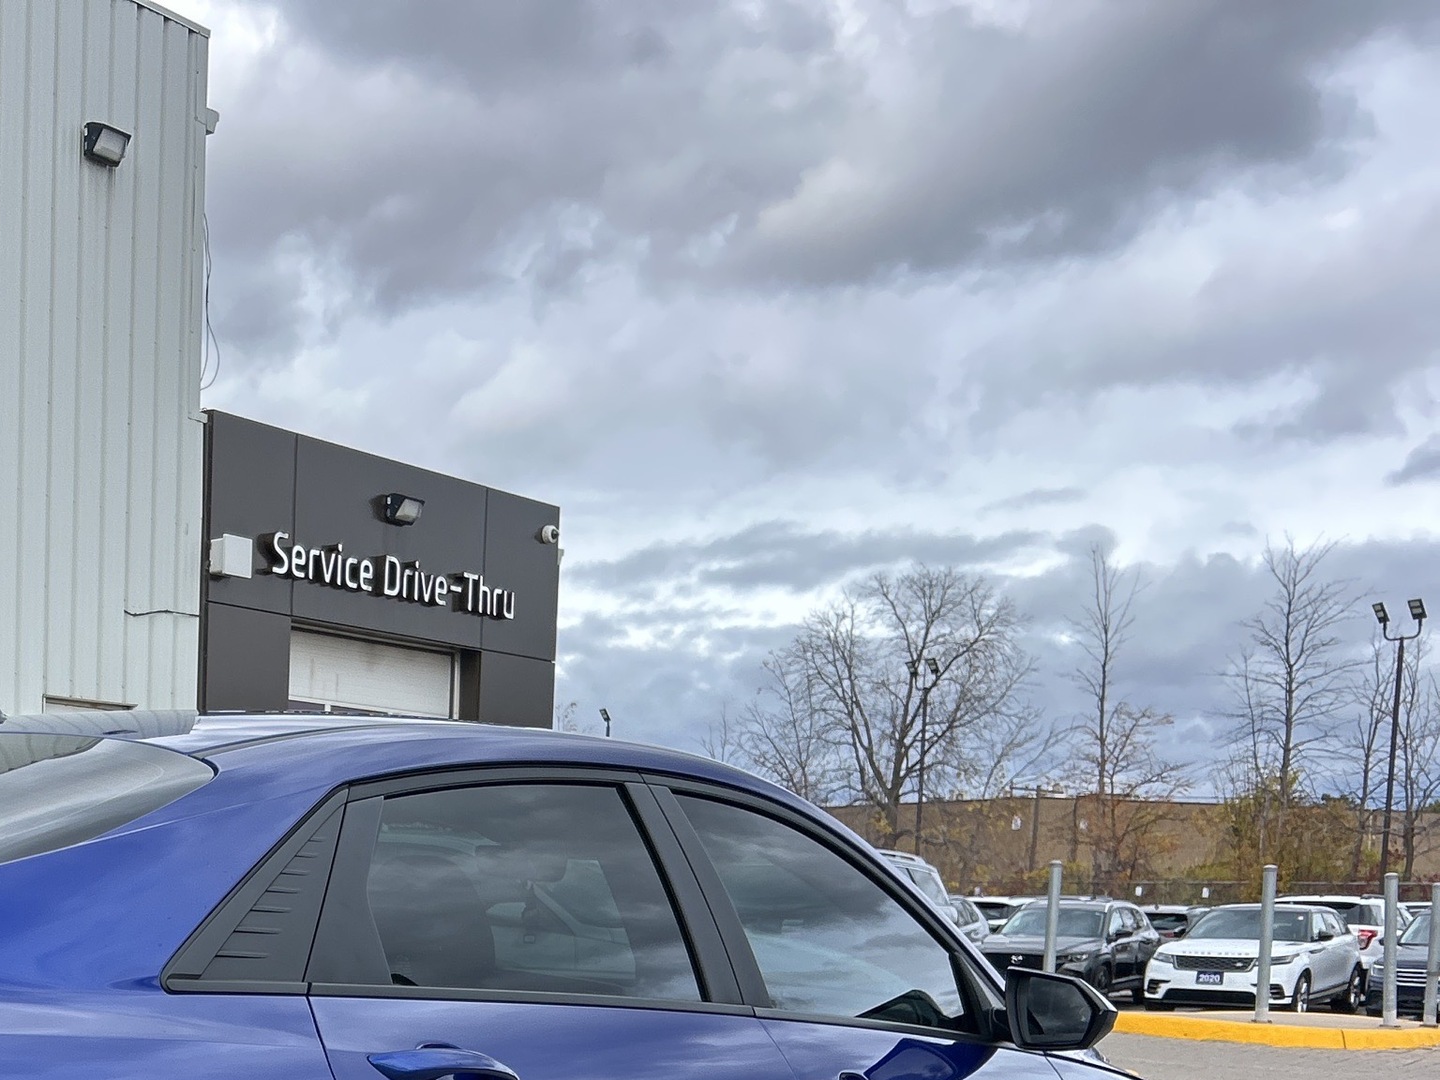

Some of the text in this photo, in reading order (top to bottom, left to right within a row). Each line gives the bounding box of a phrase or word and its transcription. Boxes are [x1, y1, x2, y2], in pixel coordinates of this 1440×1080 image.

[272, 531, 516, 620] Service Drive-Thru
[1198, 974, 1221, 983] 2020
